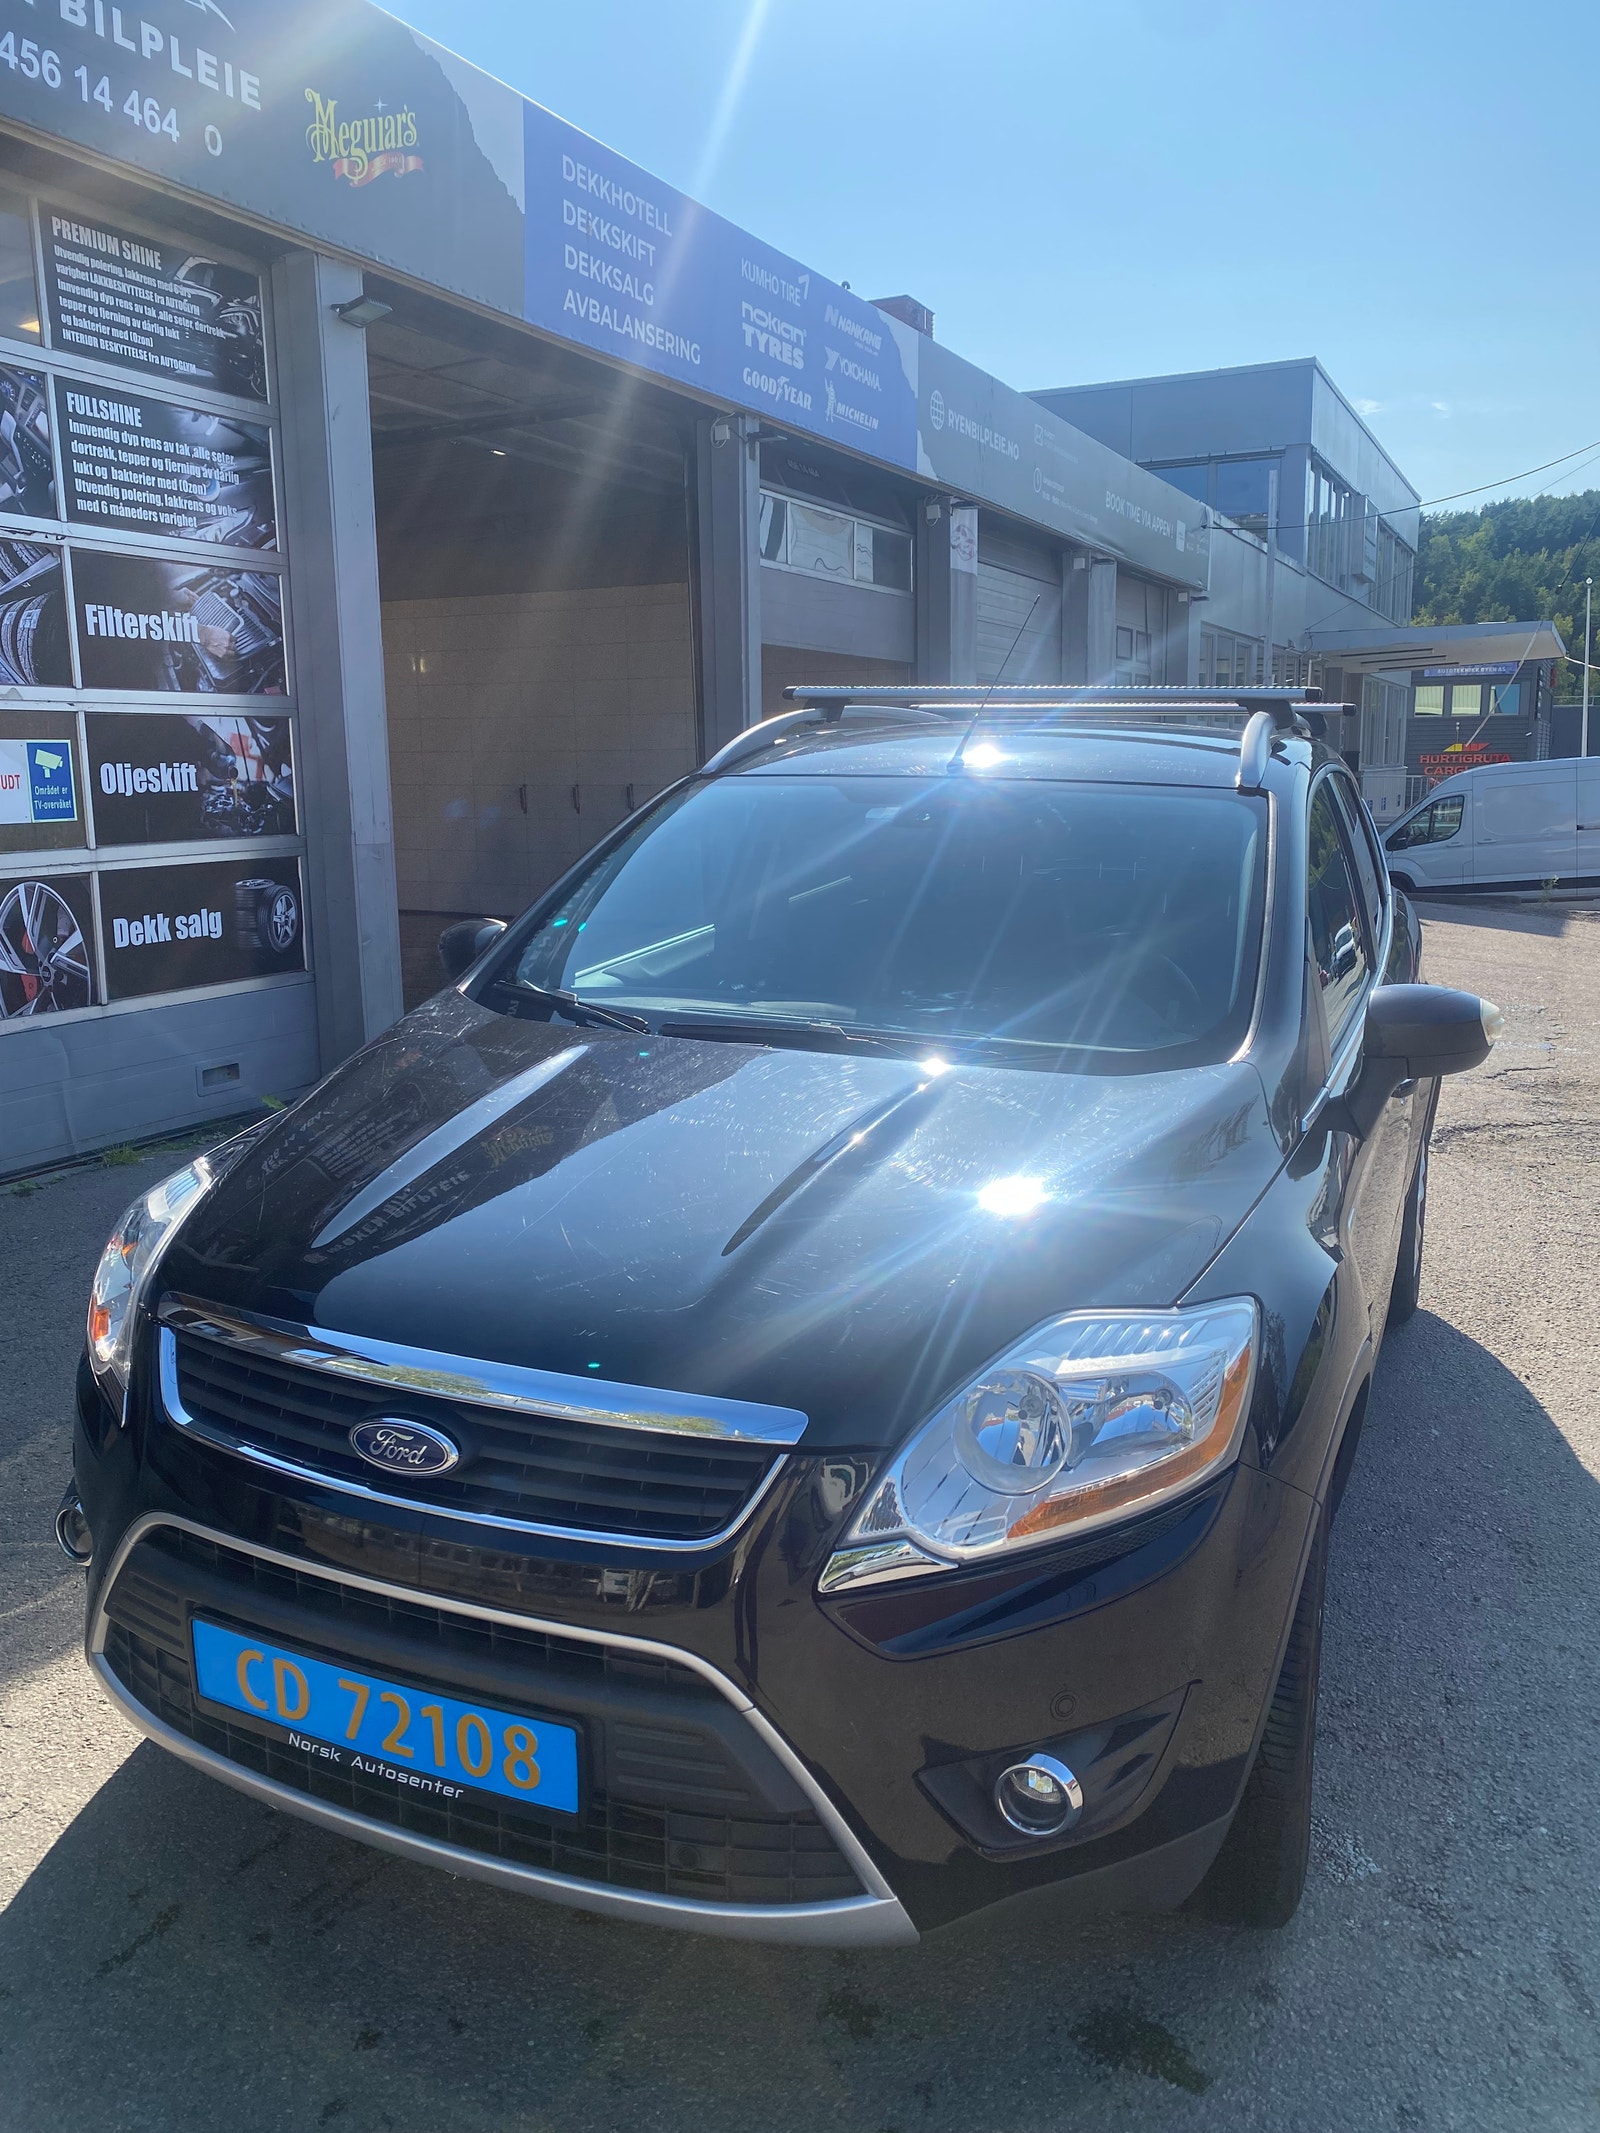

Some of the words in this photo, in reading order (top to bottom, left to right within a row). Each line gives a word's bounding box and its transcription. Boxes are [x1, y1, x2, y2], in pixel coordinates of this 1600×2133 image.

[60, 0, 261, 110] BILPLEIE
[0, 31, 62, 89] 456
[74, 65, 114, 113] 14
[123, 89, 180, 143] 464
[305, 88, 417, 182] Meguiar's
[562, 155, 672, 237] DEKKHOTELL
[52, 216, 120, 257] PREMIUM
[121, 240, 162, 271] SHINE
[563, 199, 656, 267] DEKKSKIFT
[54, 244, 90, 268] Utvendig
[55, 263, 90, 282] varighet
[564, 244, 654, 306] DEKKSALG
[57, 278, 99, 302] Innvendig
[100, 291, 115, 306] dyp
[115, 298, 133, 311] rens
[134, 303, 144, 314] av
[741, 257, 779, 296] KUMHO
[780, 279, 801, 307] TIRE
[59, 295, 87, 313] tepper
[88, 305, 99, 318] og
[132, 318, 141, 329] av
[61, 313, 72, 326] og
[73, 315, 110, 336] bakterier
[111, 327, 129, 340] med
[563, 288, 700, 365] AVBALANSERING
[742, 322, 804, 370] TYRES
[838, 315, 882, 350] NANKANG
[100, 338, 148, 363] BESKYTTELSE
[149, 352, 160, 365] fra
[160, 355, 197, 375] AUTOGLYM
[839, 356, 882, 391] YOKOHAMA
[66, 391, 143, 428] FULLSHINE
[837, 402, 879, 430] MICHELIN
[68, 418, 120, 444] Innvendig
[121, 431, 139, 447] dyp
[141, 436, 163, 451] rens
[163, 441, 175, 453] av
[175, 442, 191, 457] tak
[948, 408, 1019, 461] RYENBILPLEIE.NO
[72, 459, 94, 475] lukt
[94, 466, 108, 481] og
[111, 466, 156, 488] bakterier
[157, 477, 178, 492] med
[178, 479, 208, 497] (Ozon)
[118, 449, 150, 469] tepper
[151, 457, 164, 472] og
[165, 458, 201, 479] fjerning
[202, 466, 212, 480] av
[75, 478, 120, 500] Utvendig
[121, 487, 164, 507] polering,
[164, 493, 204, 513] lakkrens
[205, 503, 217, 517] og
[217, 504, 238, 518] voks
[77, 498, 100, 513] med
[101, 500, 108, 514] 6
[109, 502, 158, 522] måneders
[159, 511, 198, 529] varighet
[1105, 490, 1125, 514] BOOK
[1126, 501, 1140, 523] TIME
[84, 603, 201, 644] Filterskift
[1420, 753, 1511, 764] HURTIGRUTA
[34, 785, 60, 795] Området
[62, 787, 68, 795] er
[100, 762, 199, 797] Oljeskift
[34, 798, 72, 810] TV-overvåket
[113, 913, 172, 949] Dekk
[176, 908, 223, 940] salg
[369, 1427, 427, 1466] Ford
[236, 1649, 310, 1722] CD
[338, 1678, 541, 1790] 72108
[288, 1732, 342, 1763] Norsk
[350, 1755, 465, 1799] Autosenter
